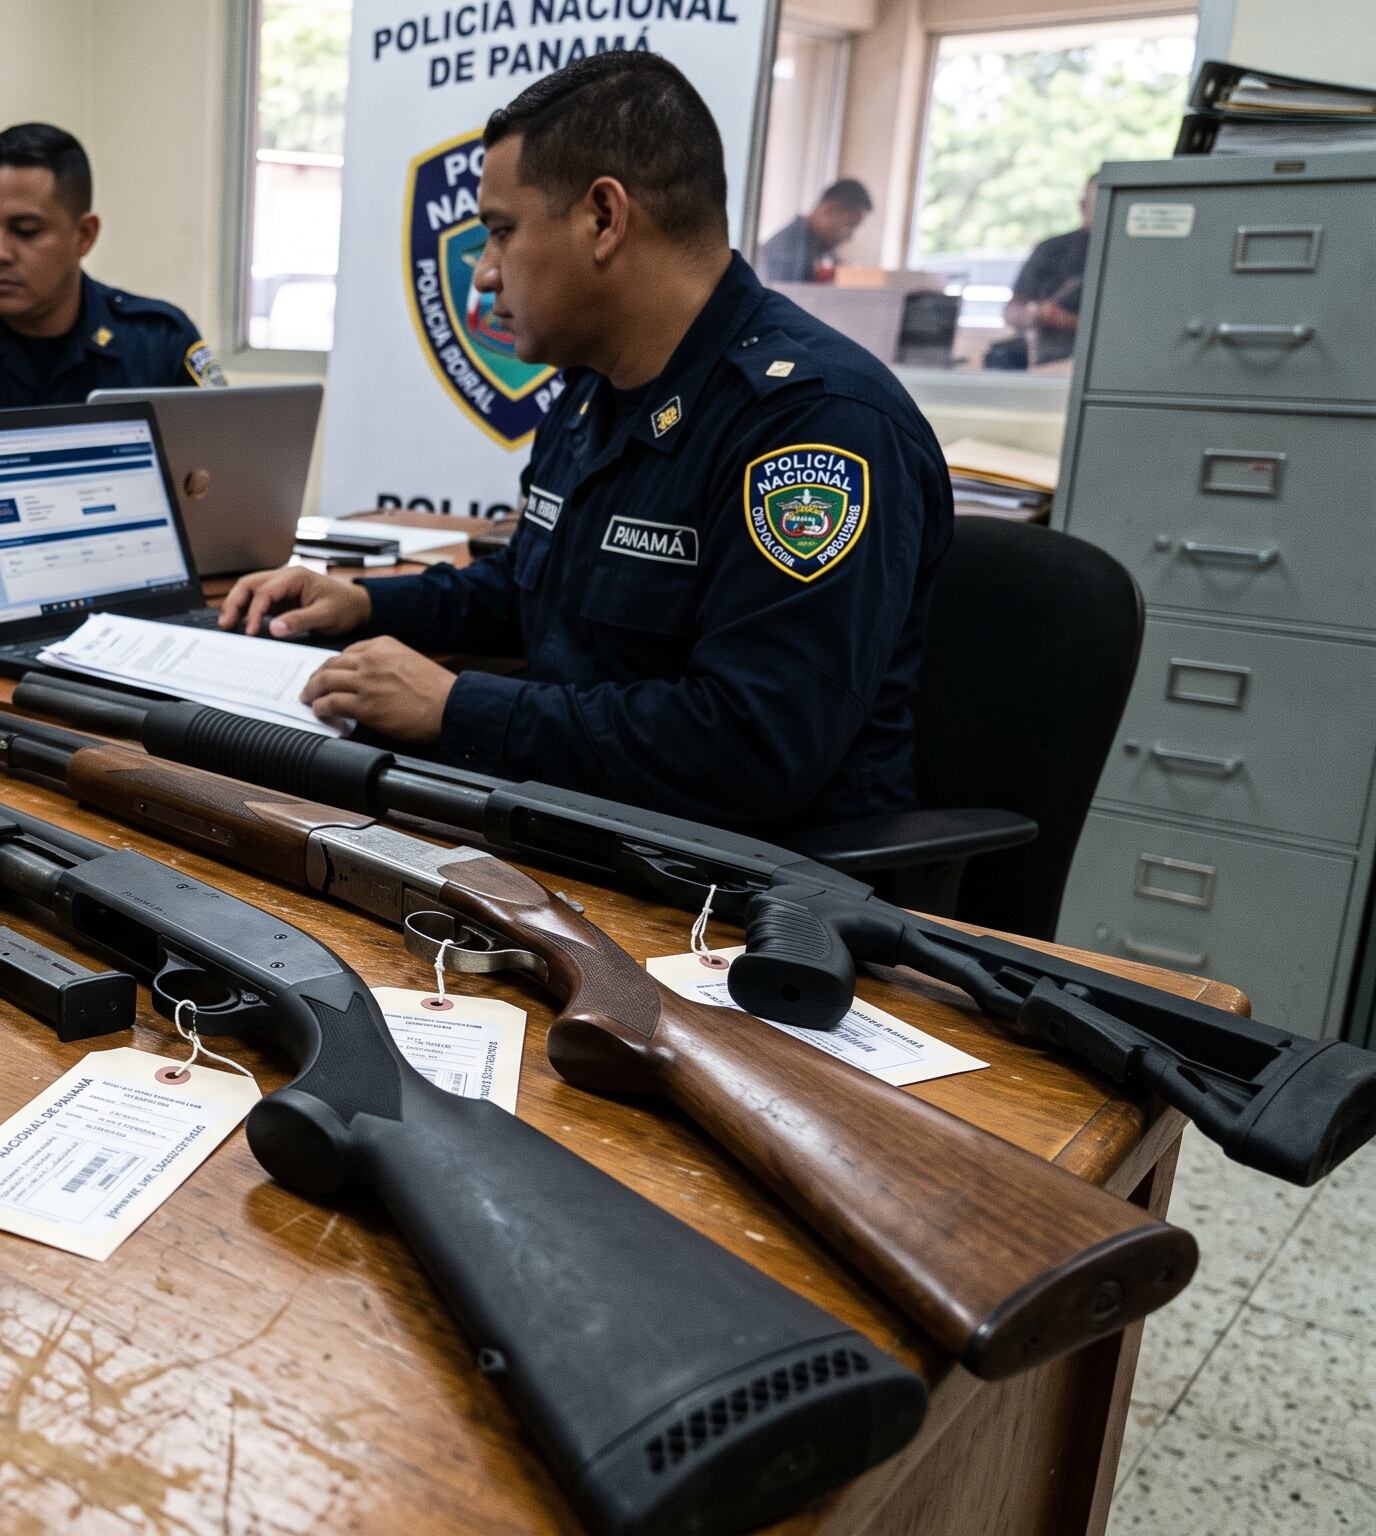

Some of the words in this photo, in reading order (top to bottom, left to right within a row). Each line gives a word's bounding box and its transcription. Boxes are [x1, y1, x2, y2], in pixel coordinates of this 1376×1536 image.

[530, 0, 739, 25] NACIONAL
[429, 51, 474, 89] DE
[763, 453, 846, 477] POLICÍA
[757, 469, 852, 495] NACIONAL
[613, 525, 685, 557] PANAMÁ
